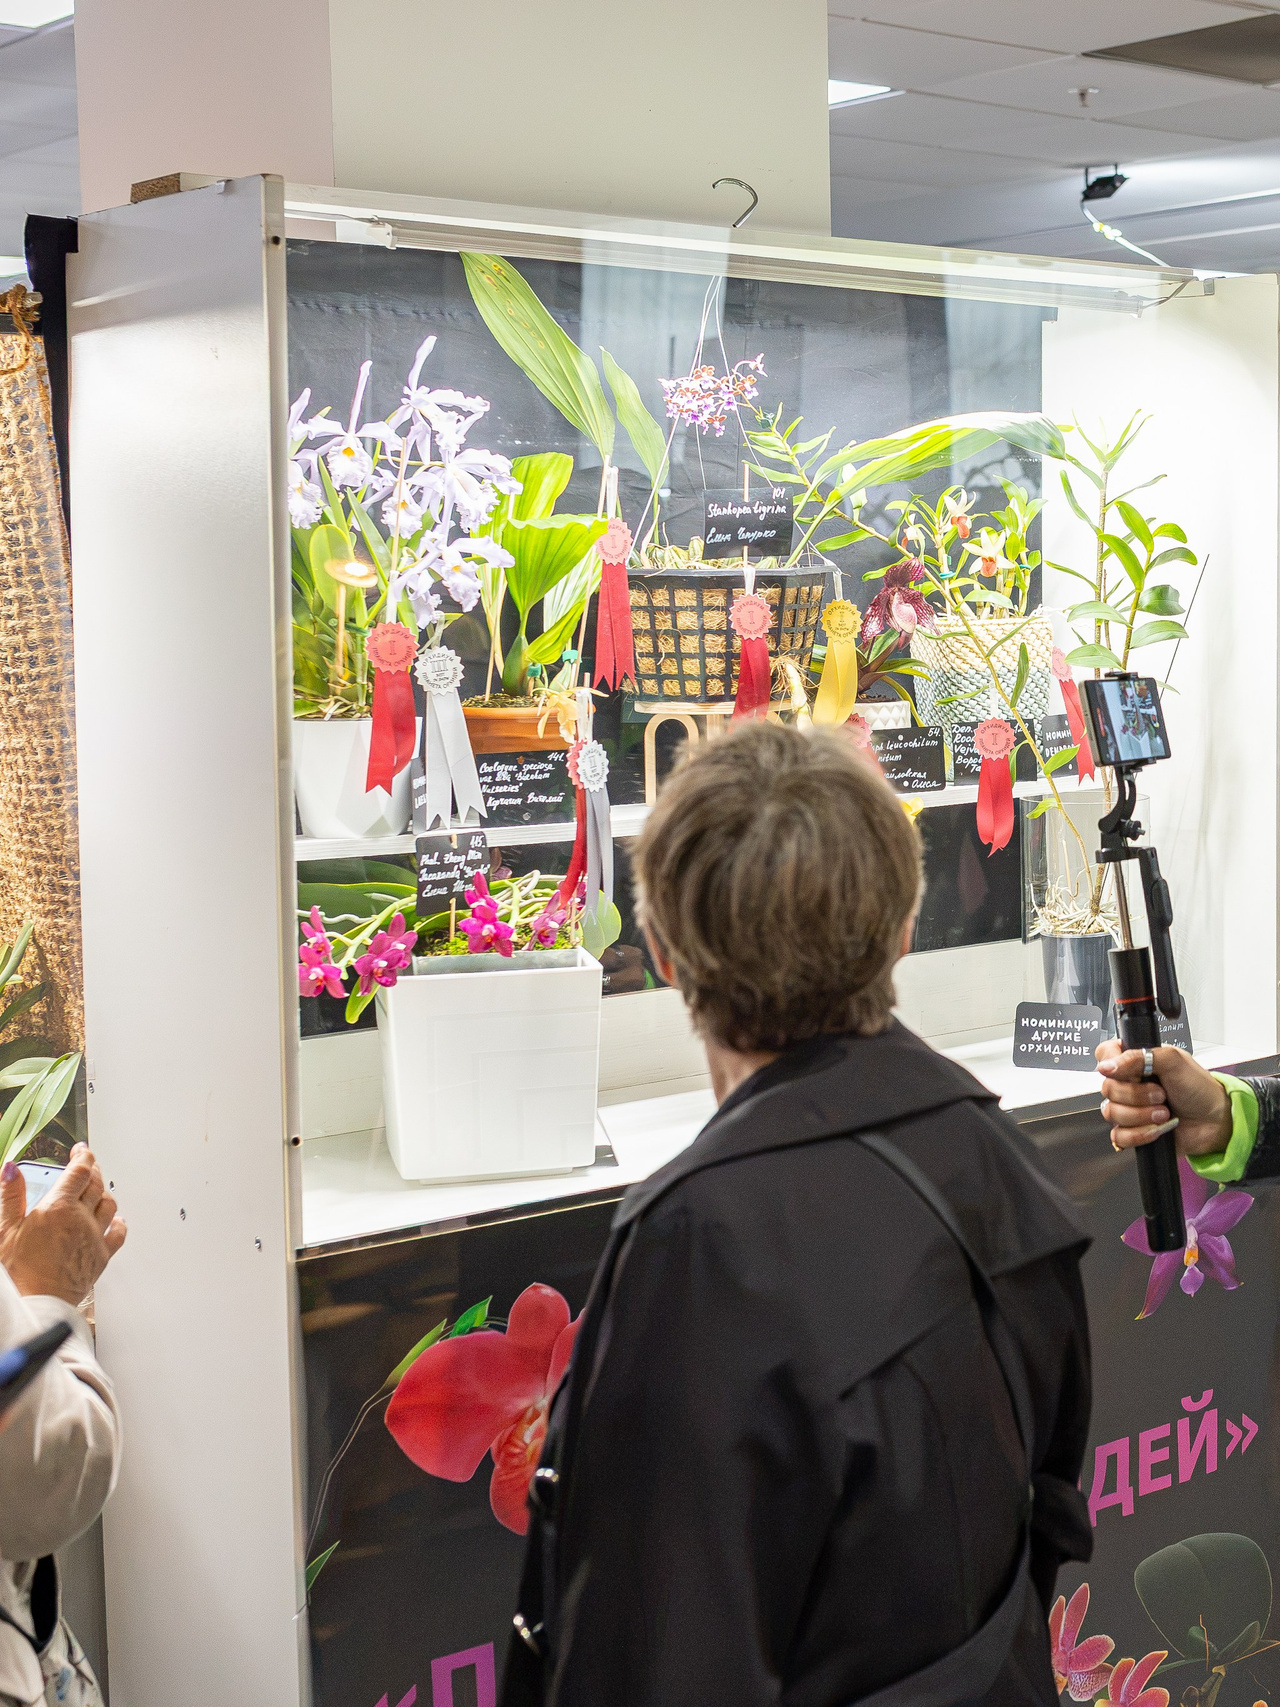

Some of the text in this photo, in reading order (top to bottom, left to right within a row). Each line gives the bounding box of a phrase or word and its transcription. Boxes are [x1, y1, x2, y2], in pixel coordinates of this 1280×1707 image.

[707, 501, 787, 521] Stanhopea tigrina
[928, 727, 941, 737] 54.
[1021, 1017, 1099, 1031] НОМИНАЦИЯ
[1031, 1030, 1082, 1042] ДРУГИЕ
[1019, 1043, 1091, 1056] ОРХИДНЫЕ
[1077, 1388, 1259, 1528] ДЕЙ»
